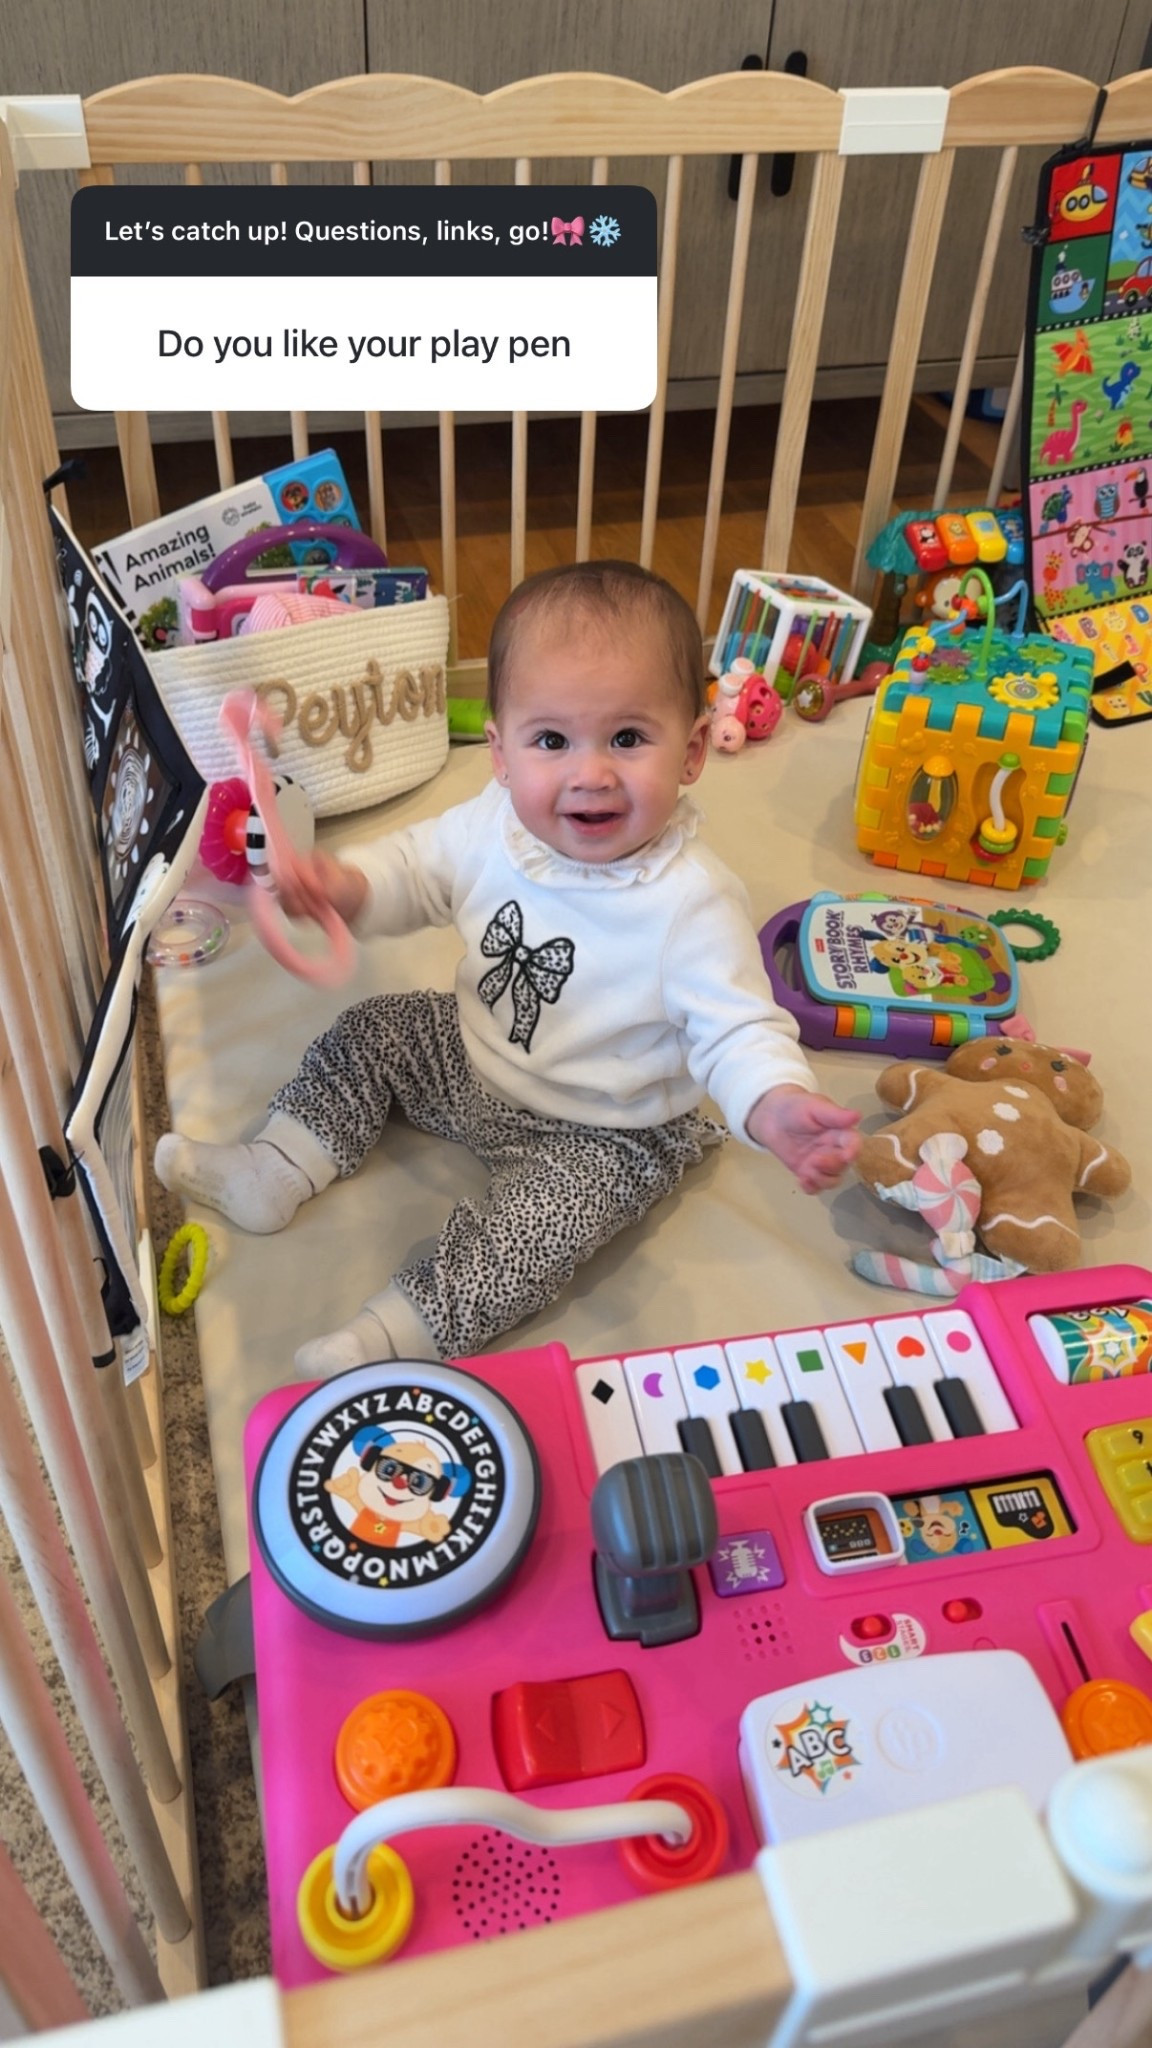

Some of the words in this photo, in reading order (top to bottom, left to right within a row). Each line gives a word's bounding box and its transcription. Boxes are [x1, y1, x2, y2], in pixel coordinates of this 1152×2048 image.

[126, 525, 211, 572] Amazing
[135, 543, 216, 592] Animals!
[253, 657, 446, 773] Peyton
[825, 908, 857, 989] STORYBOOK
[846, 924, 871, 974] RHYMES
[903, 1618, 921, 1651] SMART
[786, 1727, 853, 1777] ABC
